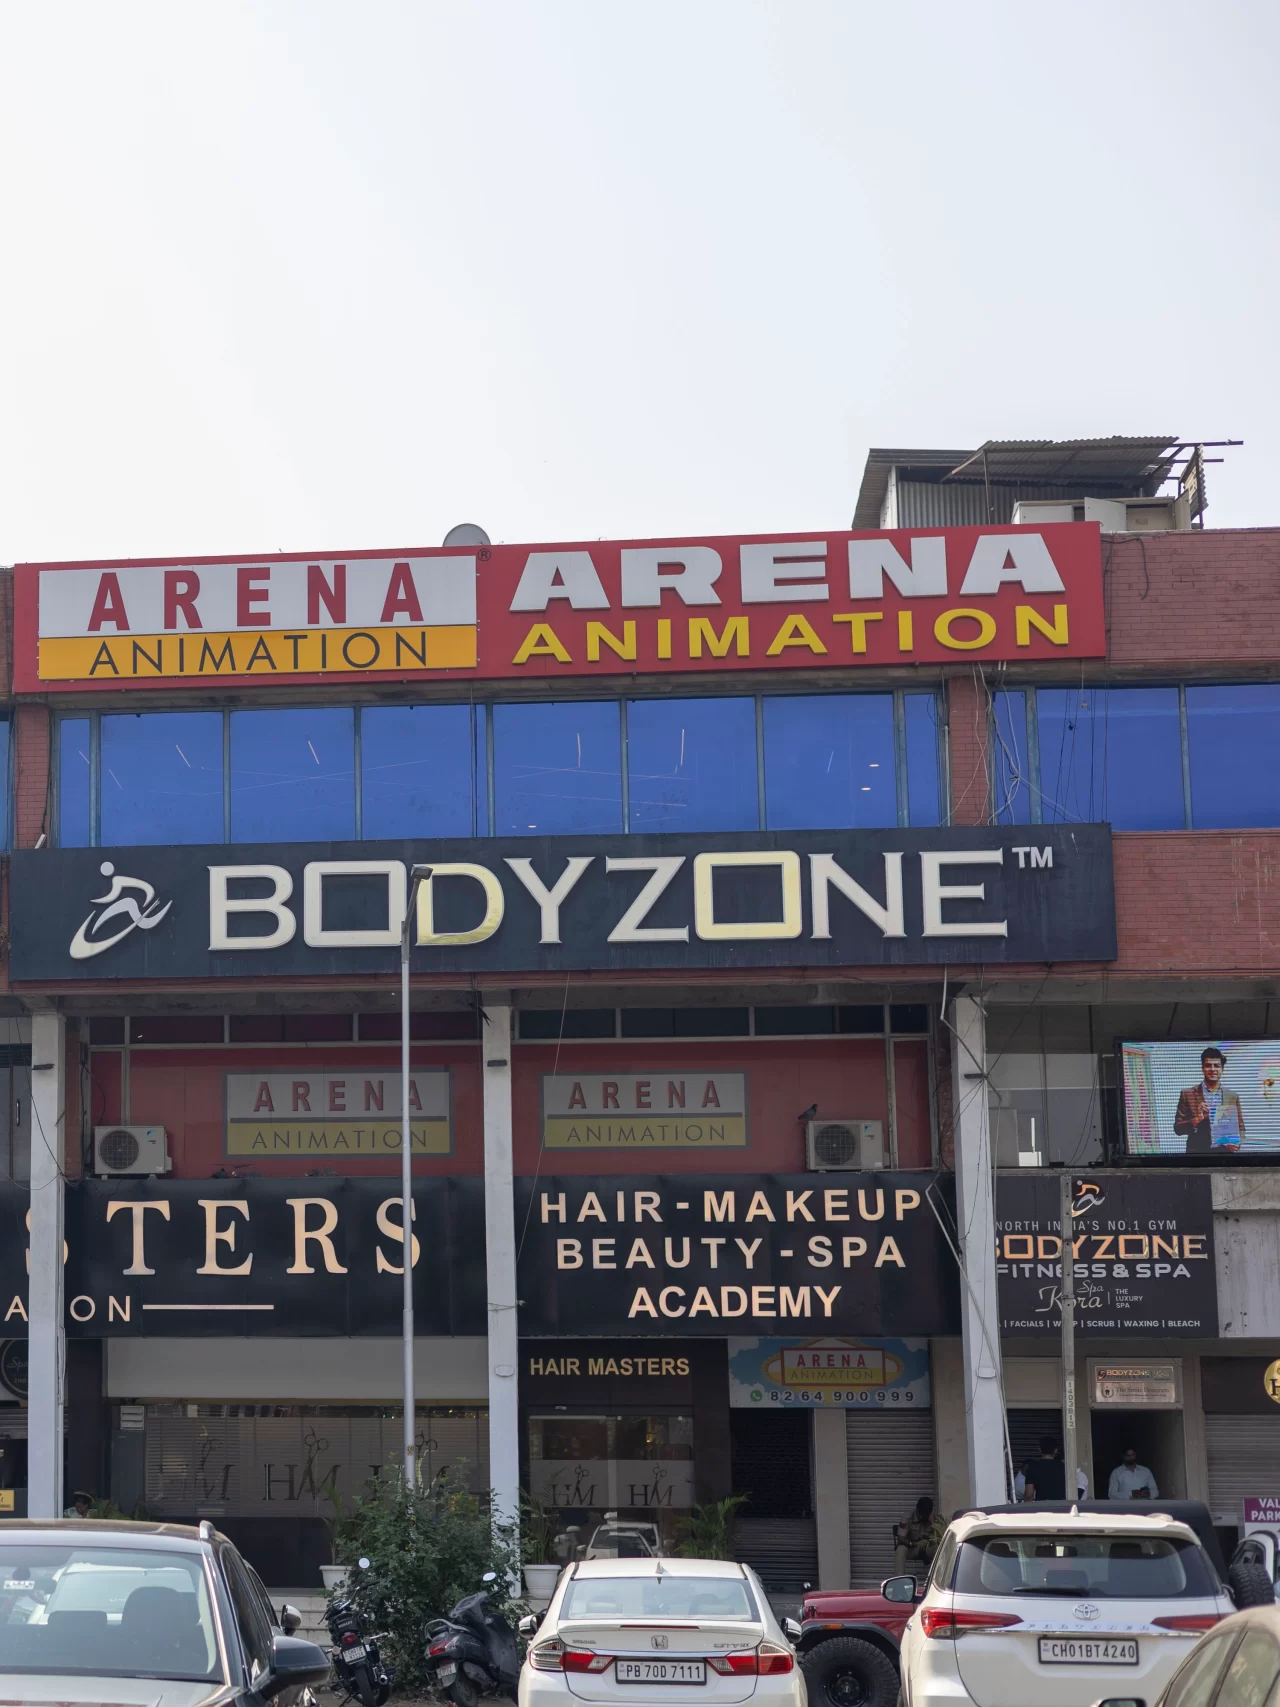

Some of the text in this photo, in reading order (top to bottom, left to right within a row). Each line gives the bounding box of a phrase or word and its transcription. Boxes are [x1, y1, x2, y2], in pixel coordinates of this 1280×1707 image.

[510, 532, 1066, 612] ARENA
[87, 564, 425, 632] ARENA
[512, 603, 1069, 666] ANIMATION
[89, 631, 429, 678] ANIMATION
[208, 848, 1008, 951] BODYZONE
[253, 1080, 423, 1113] ARENA
[568, 1080, 720, 1110] ARENA
[252, 1128, 427, 1150] ANIMATION
[567, 1124, 726, 1143] ANIMATION
[995, 1220, 1176, 1231] NORTH INIA'S NO.1 GYM
[995, 1234, 1208, 1260] ODYZONE
[1112, 1263, 1129, 1278] &
[1135, 1263, 1191, 1278] SPA
[1076, 1280, 1104, 1297] Spa
[628, 1286, 842, 1318] ACADEMY
[1035, 1285, 1103, 1312] Kra
[1010, 1320, 1044, 1328] FACIALS
[1053, 1320, 1078, 1328] WP
[1087, 1320, 1115, 1328] SCRUB
[530, 1357, 690, 1376] HAIR MASTERS
[797, 1354, 866, 1367] ARENA
[791, 1369, 873, 1380] ANIMATION
[1259, 1498, 1280, 1509] VAL
[1251, 1511, 1280, 1521] PARK
[1052, 1644, 1135, 1658] CH01BT4240
[626, 1665, 700, 1679] PB 70D 7111
